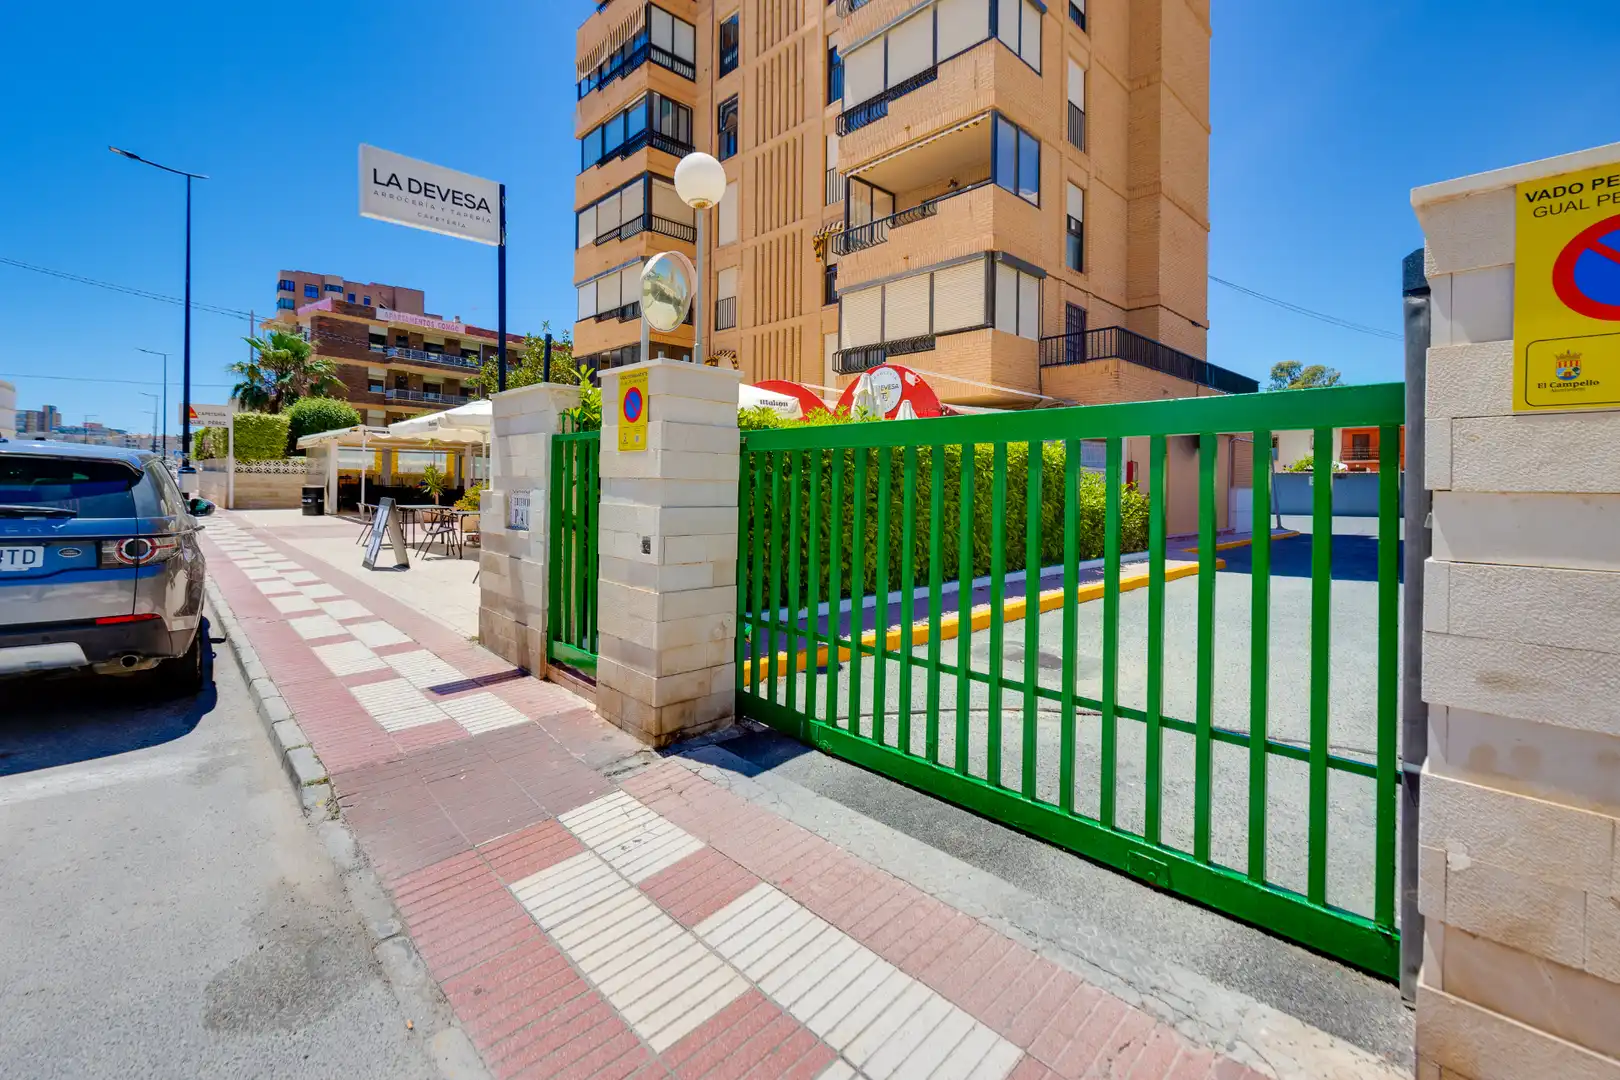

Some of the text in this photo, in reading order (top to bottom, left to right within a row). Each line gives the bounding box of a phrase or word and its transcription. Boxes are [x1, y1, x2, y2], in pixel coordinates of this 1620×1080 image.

[373, 168, 491, 214] LA DEVESA
[1525, 183, 1584, 203] VADO
[1533, 199, 1590, 218] GUAL
[879, 383, 899, 391] EVESA
[1549, 379, 1600, 389] Campello
